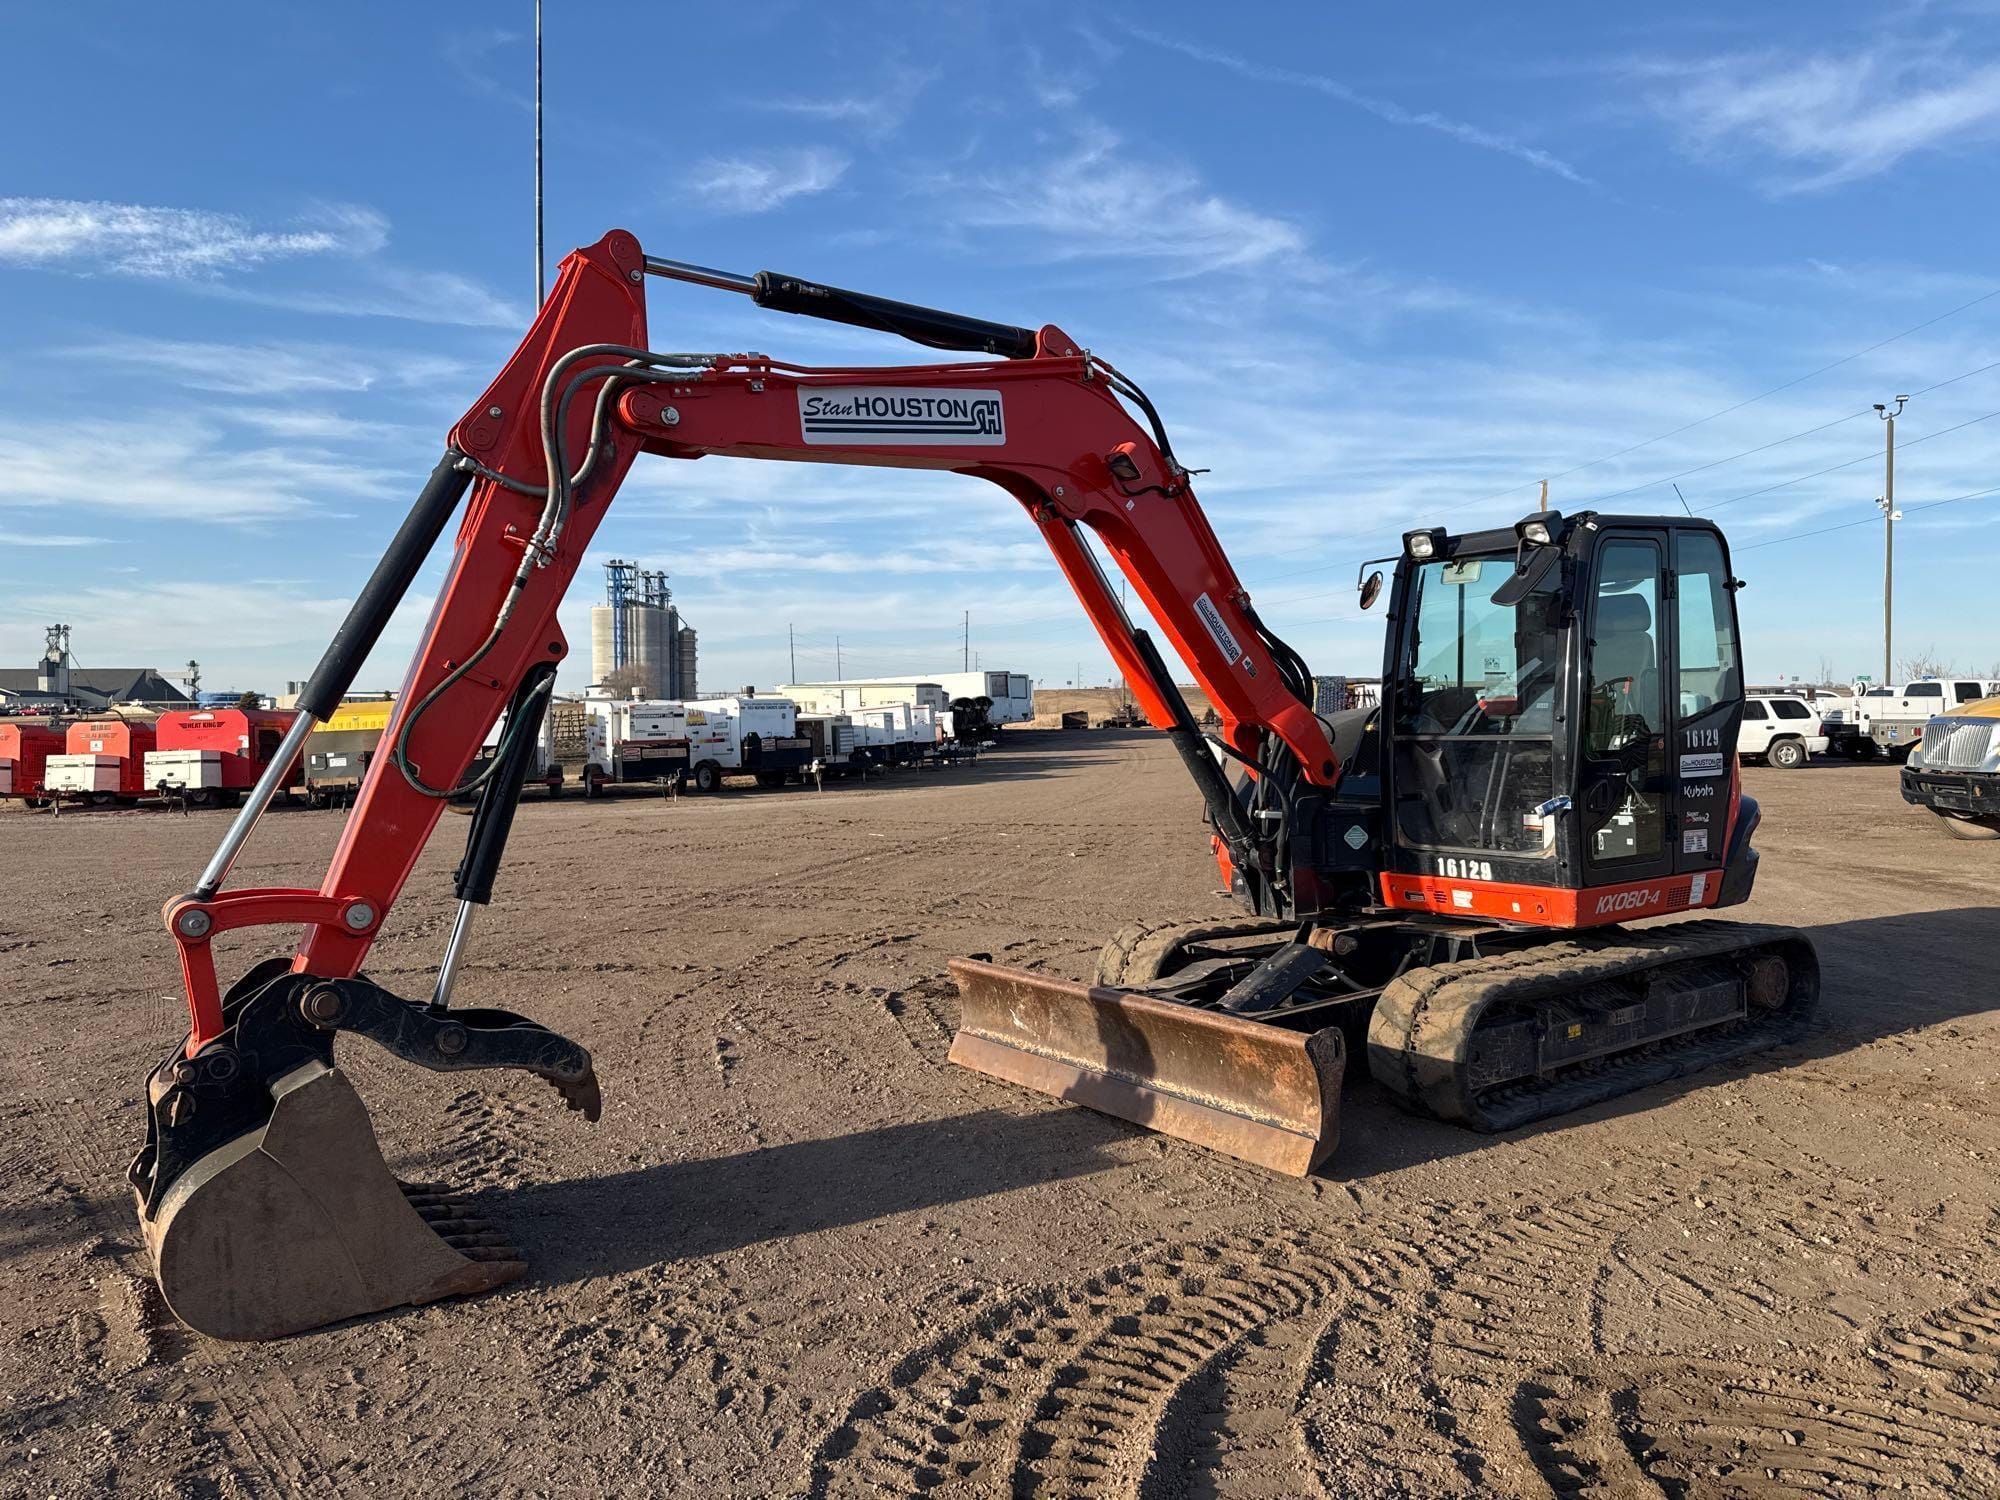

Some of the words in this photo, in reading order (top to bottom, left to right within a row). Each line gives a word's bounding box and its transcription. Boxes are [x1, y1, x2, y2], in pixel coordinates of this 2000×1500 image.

[803, 397, 853, 416] Stan
[854, 397, 968, 418] HOUSTON
[1208, 612, 1234, 647] HOUSTON
[1686, 728, 1719, 749] 16129
[1692, 759, 1716, 768] HOUSTON
[1684, 785, 1714, 799] Kubota
[1438, 858, 1493, 880] 16129
[1595, 890, 1660, 915] KX080-4
